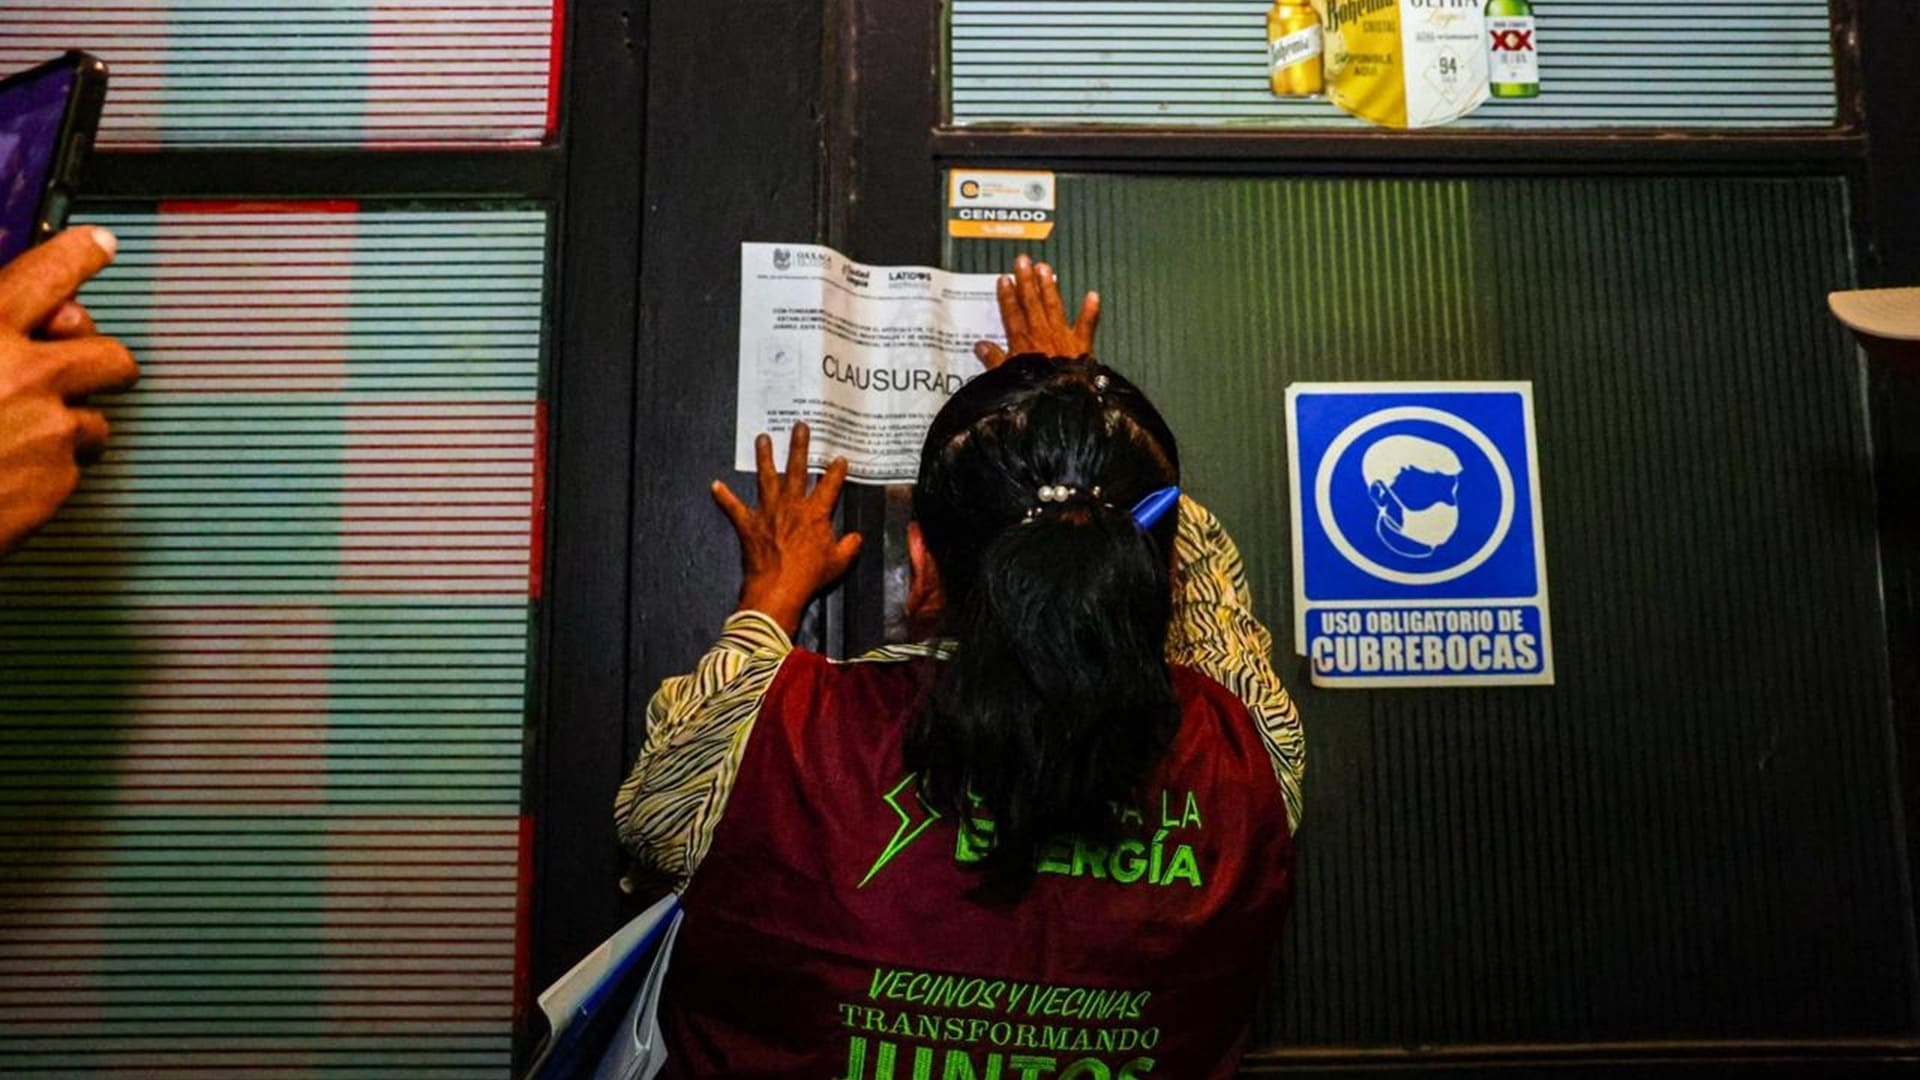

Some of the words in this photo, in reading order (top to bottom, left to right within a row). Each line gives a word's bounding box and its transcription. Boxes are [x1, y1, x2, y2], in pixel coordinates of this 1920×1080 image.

[1490, 30, 1533, 51] XX
[1440, 57, 1457, 74] 94
[959, 208, 1046, 221] CENSADO
[1321, 611, 1361, 634] USO
[1366, 609, 1493, 633] OBLIGATORIO
[1498, 609, 1523, 632] DE
[1312, 634, 1538, 673] CUBREBOCAS
[1163, 790, 1202, 829] LA
[953, 817, 1202, 887] EERGÍA
[868, 967, 1005, 1010] VECINOS
[1006, 983, 1028, 1015] Y
[1027, 984, 1152, 1020] VECINAS
[839, 1003, 1160, 1051] TRANSFORMANDO
